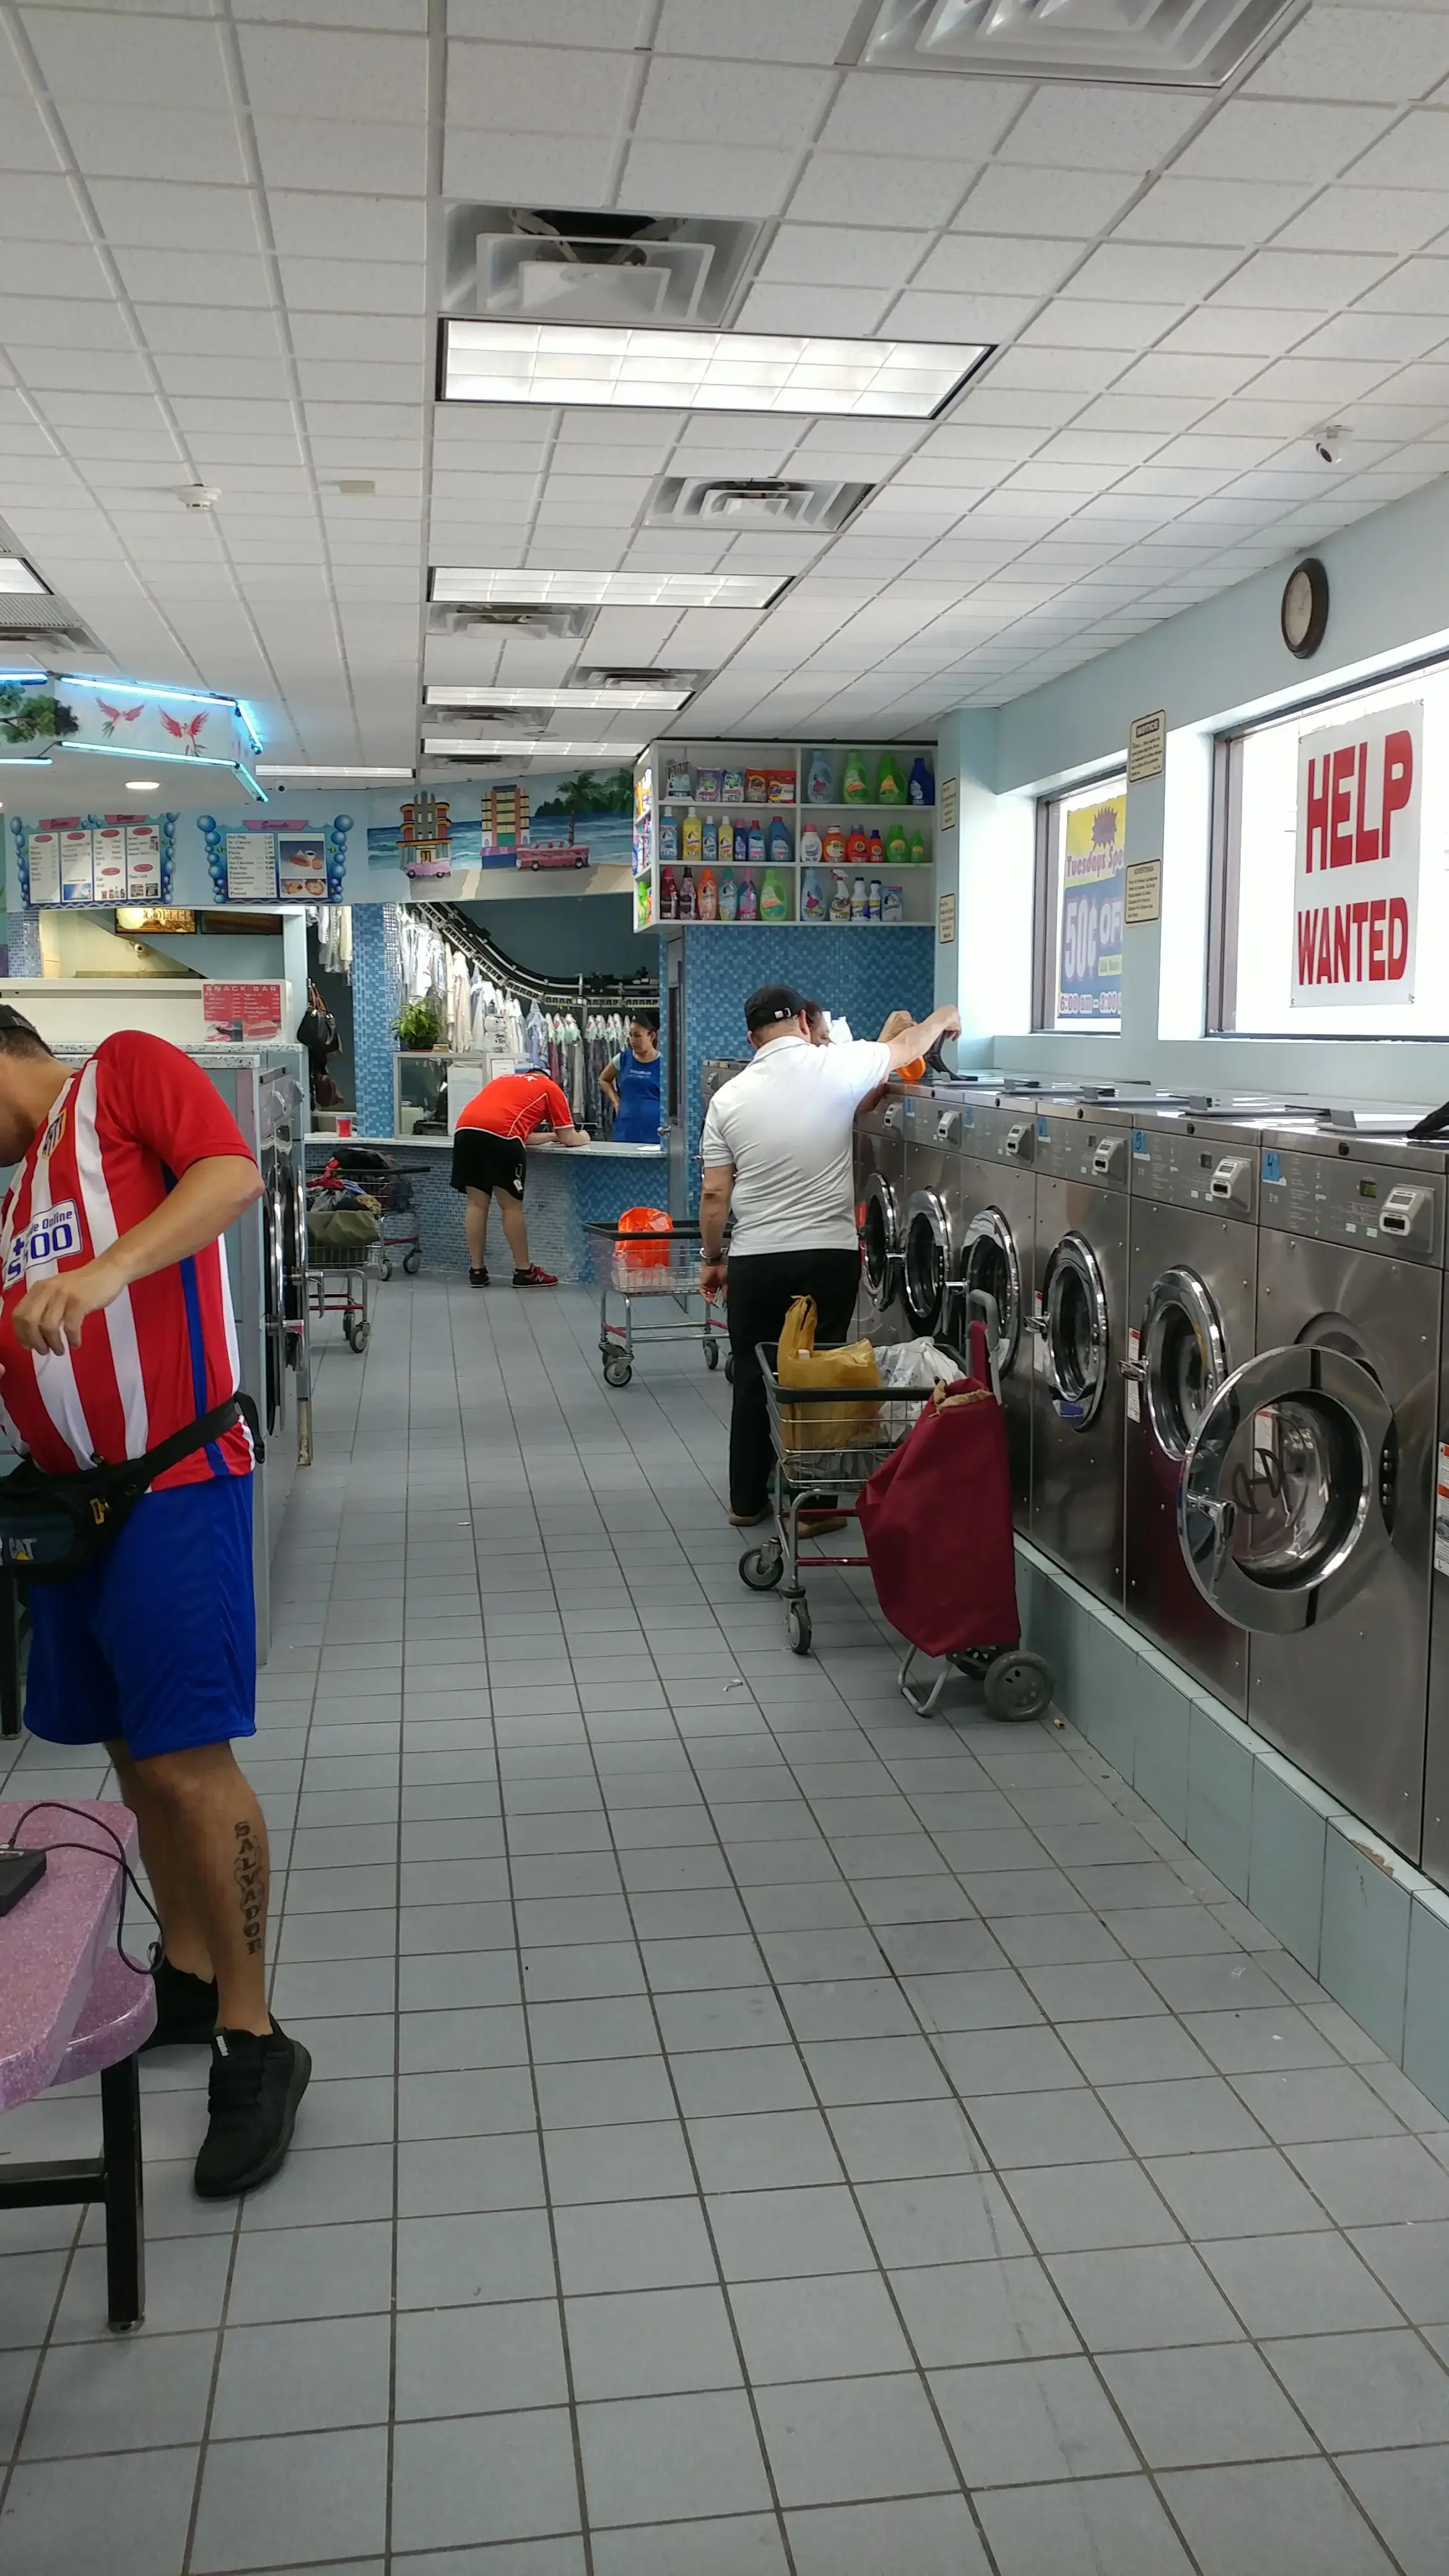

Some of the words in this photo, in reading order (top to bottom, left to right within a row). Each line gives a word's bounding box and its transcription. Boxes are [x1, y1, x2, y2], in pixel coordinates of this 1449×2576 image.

[1305, 729, 1413, 874] HELP
[1066, 851, 1106, 877] Tuesdays
[144, 909, 191, 920] COFFEE
[1297, 897, 1409, 986] WANTED
[1060, 996, 1078, 1011] 6:00
[42, 1210, 72, 1230] Online
[9, 1537, 35, 1560] CAT
